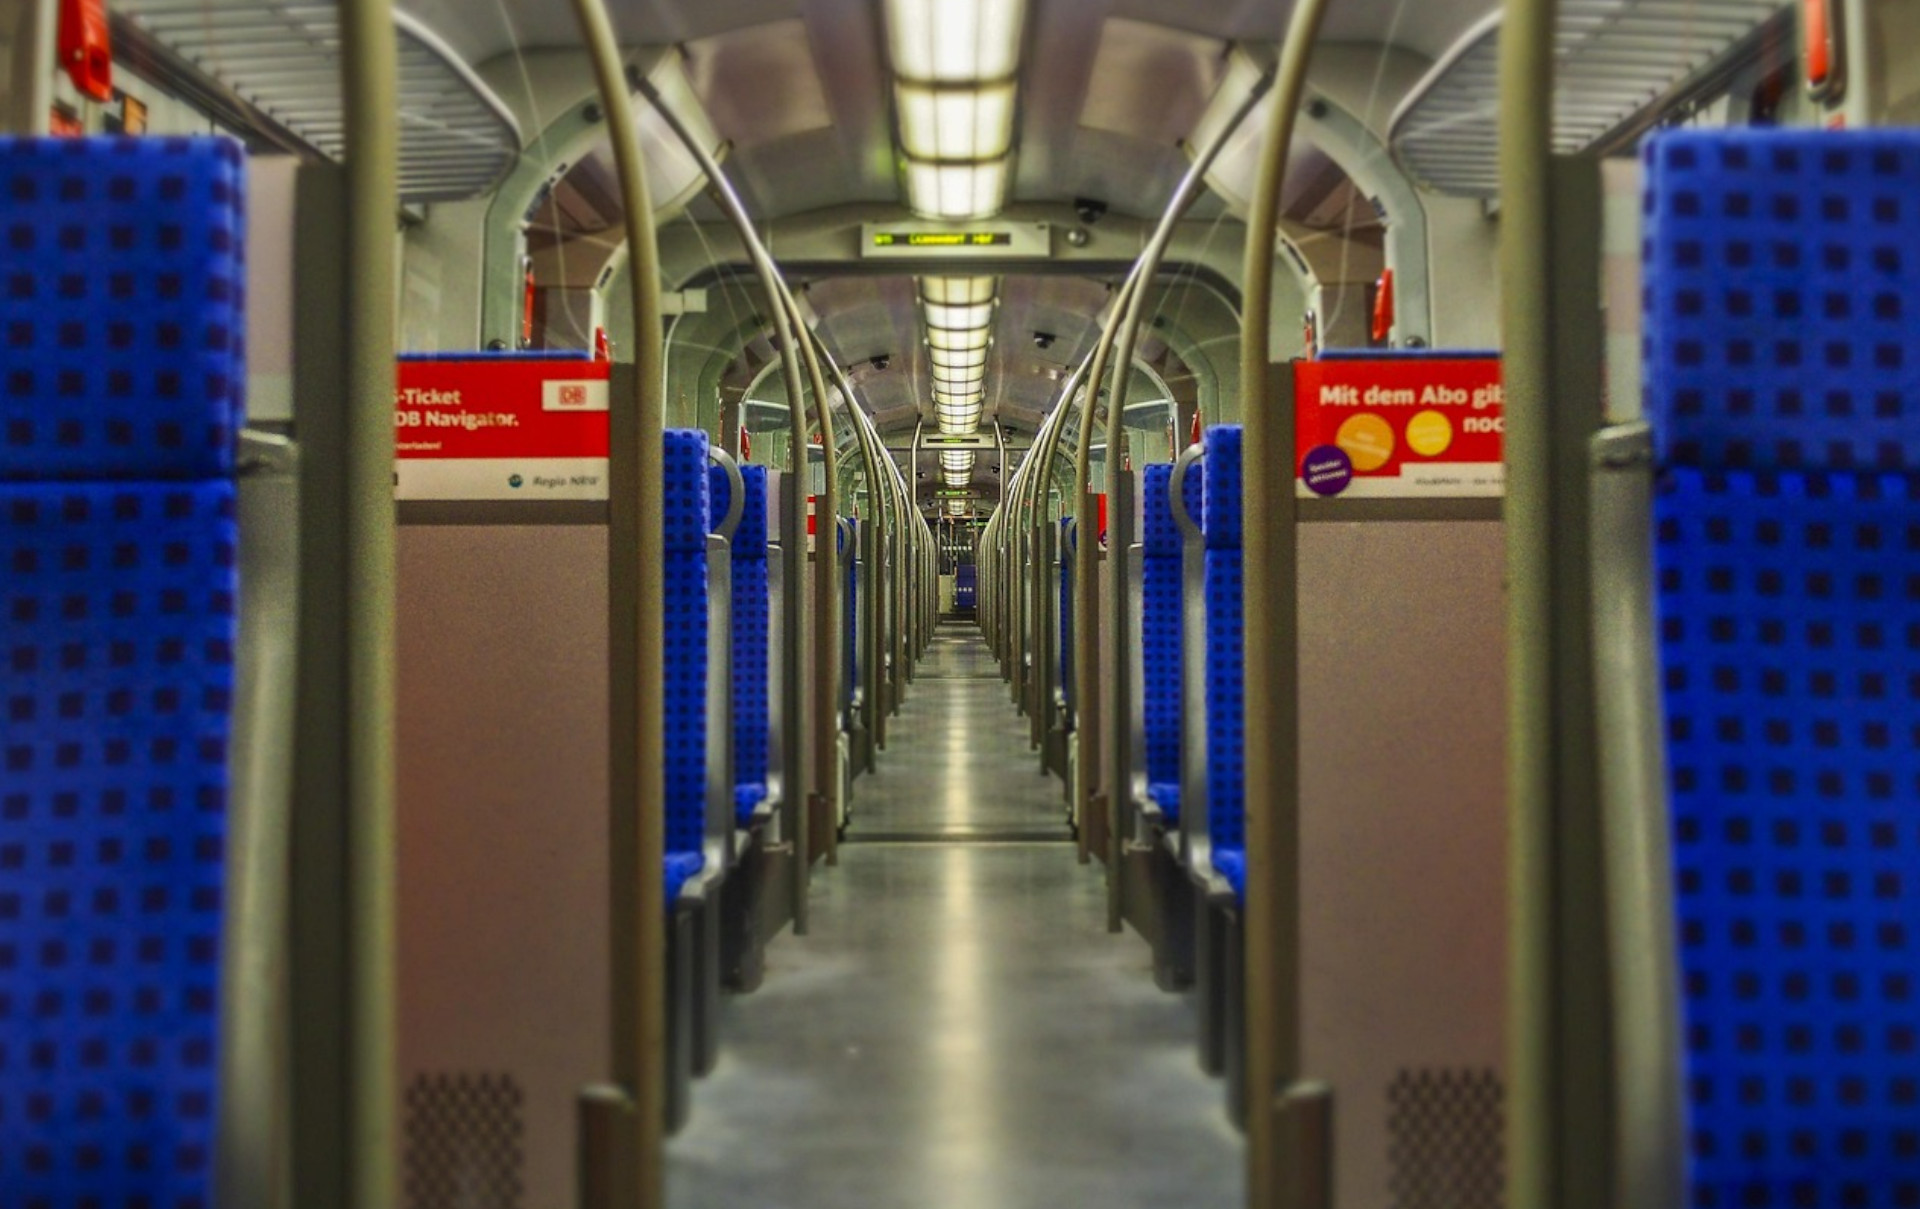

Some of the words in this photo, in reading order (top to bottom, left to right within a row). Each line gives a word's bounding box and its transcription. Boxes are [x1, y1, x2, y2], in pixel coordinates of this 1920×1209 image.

[1319, 384, 1359, 406] Mit
[1363, 384, 1415, 405] dem
[1420, 384, 1468, 405] Abo
[425, 409, 519, 431] Navigator.
